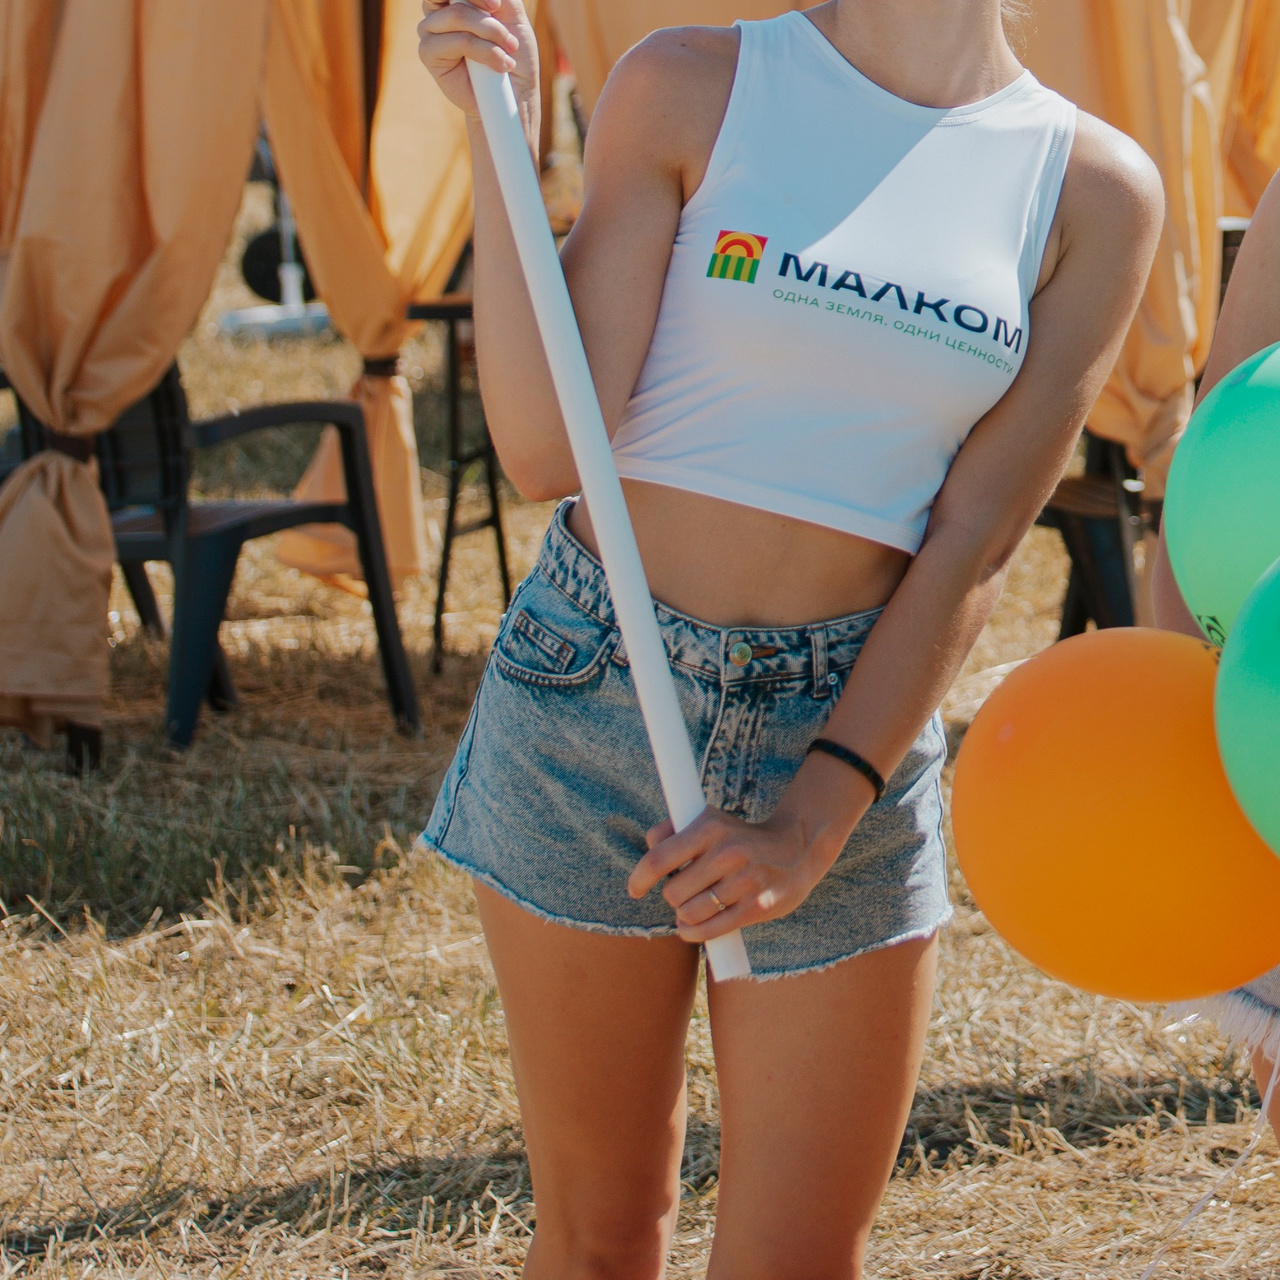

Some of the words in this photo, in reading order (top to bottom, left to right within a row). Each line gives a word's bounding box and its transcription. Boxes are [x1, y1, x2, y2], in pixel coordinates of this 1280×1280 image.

[772, 288, 820, 308] ОДНА
[825, 300, 888, 326] ЗЕМЛЯ.
[893, 320, 941, 342] ОДНИ
[944, 335, 1015, 375] ЦЕННОСТИ
[777, 252, 1023, 354] МАЛКОМ
